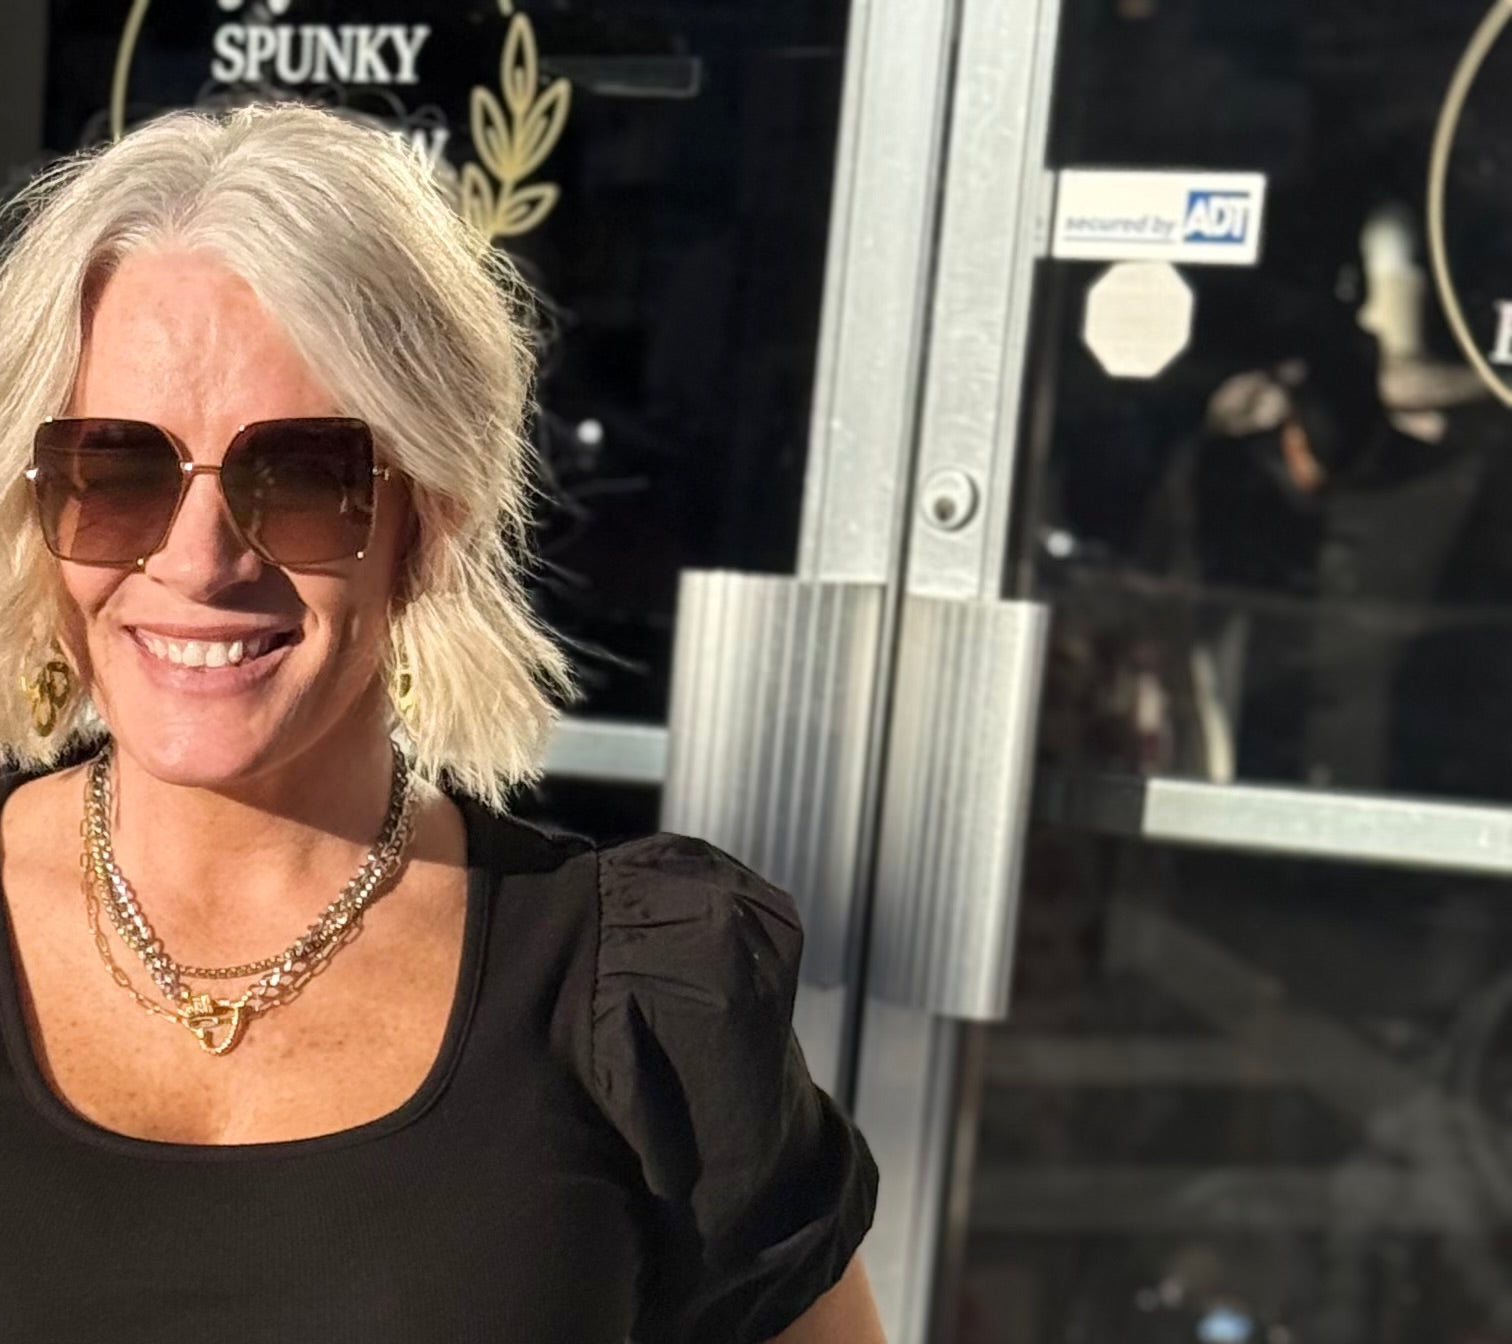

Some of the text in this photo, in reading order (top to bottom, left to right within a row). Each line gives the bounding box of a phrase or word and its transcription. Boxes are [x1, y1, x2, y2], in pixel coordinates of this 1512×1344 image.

[210, 23, 431, 84] SPUNKY
[1065, 194, 1249, 240] secured by ADT
